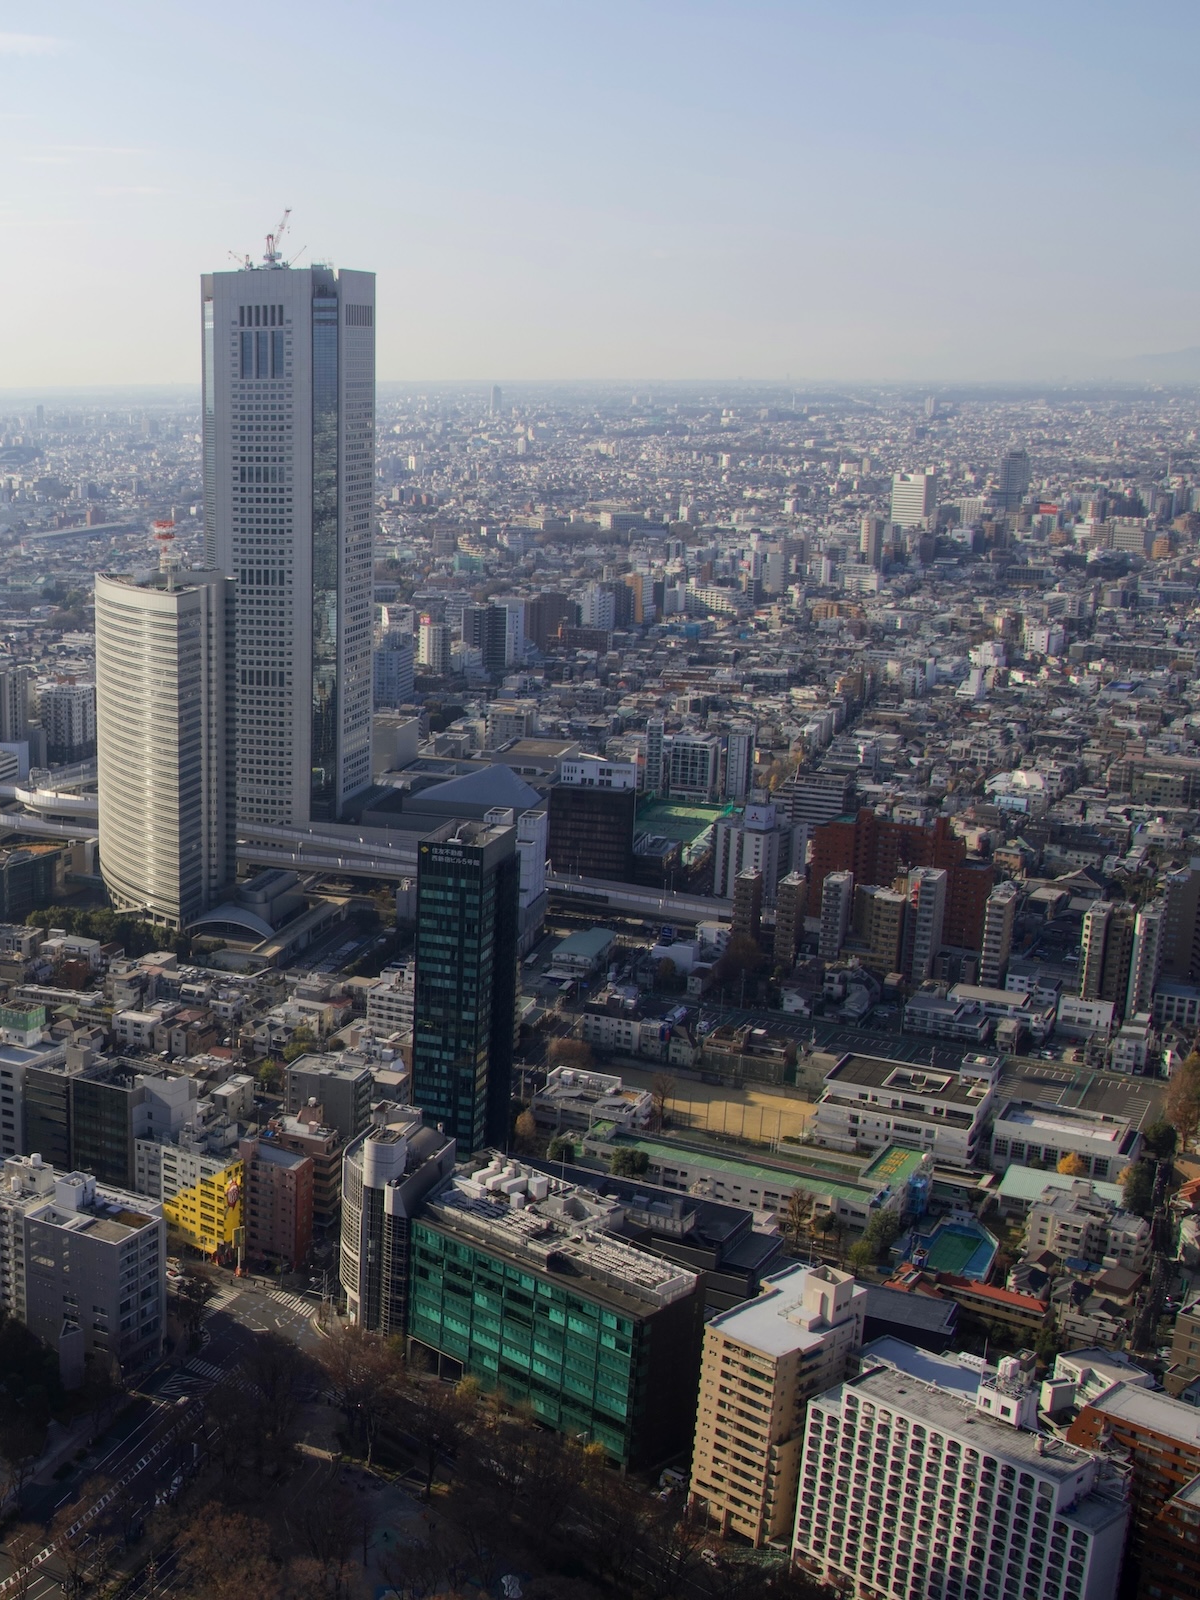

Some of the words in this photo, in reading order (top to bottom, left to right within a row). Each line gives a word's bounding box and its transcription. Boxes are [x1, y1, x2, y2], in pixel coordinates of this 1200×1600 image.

[431, 848, 463, 856] 住友不動産
